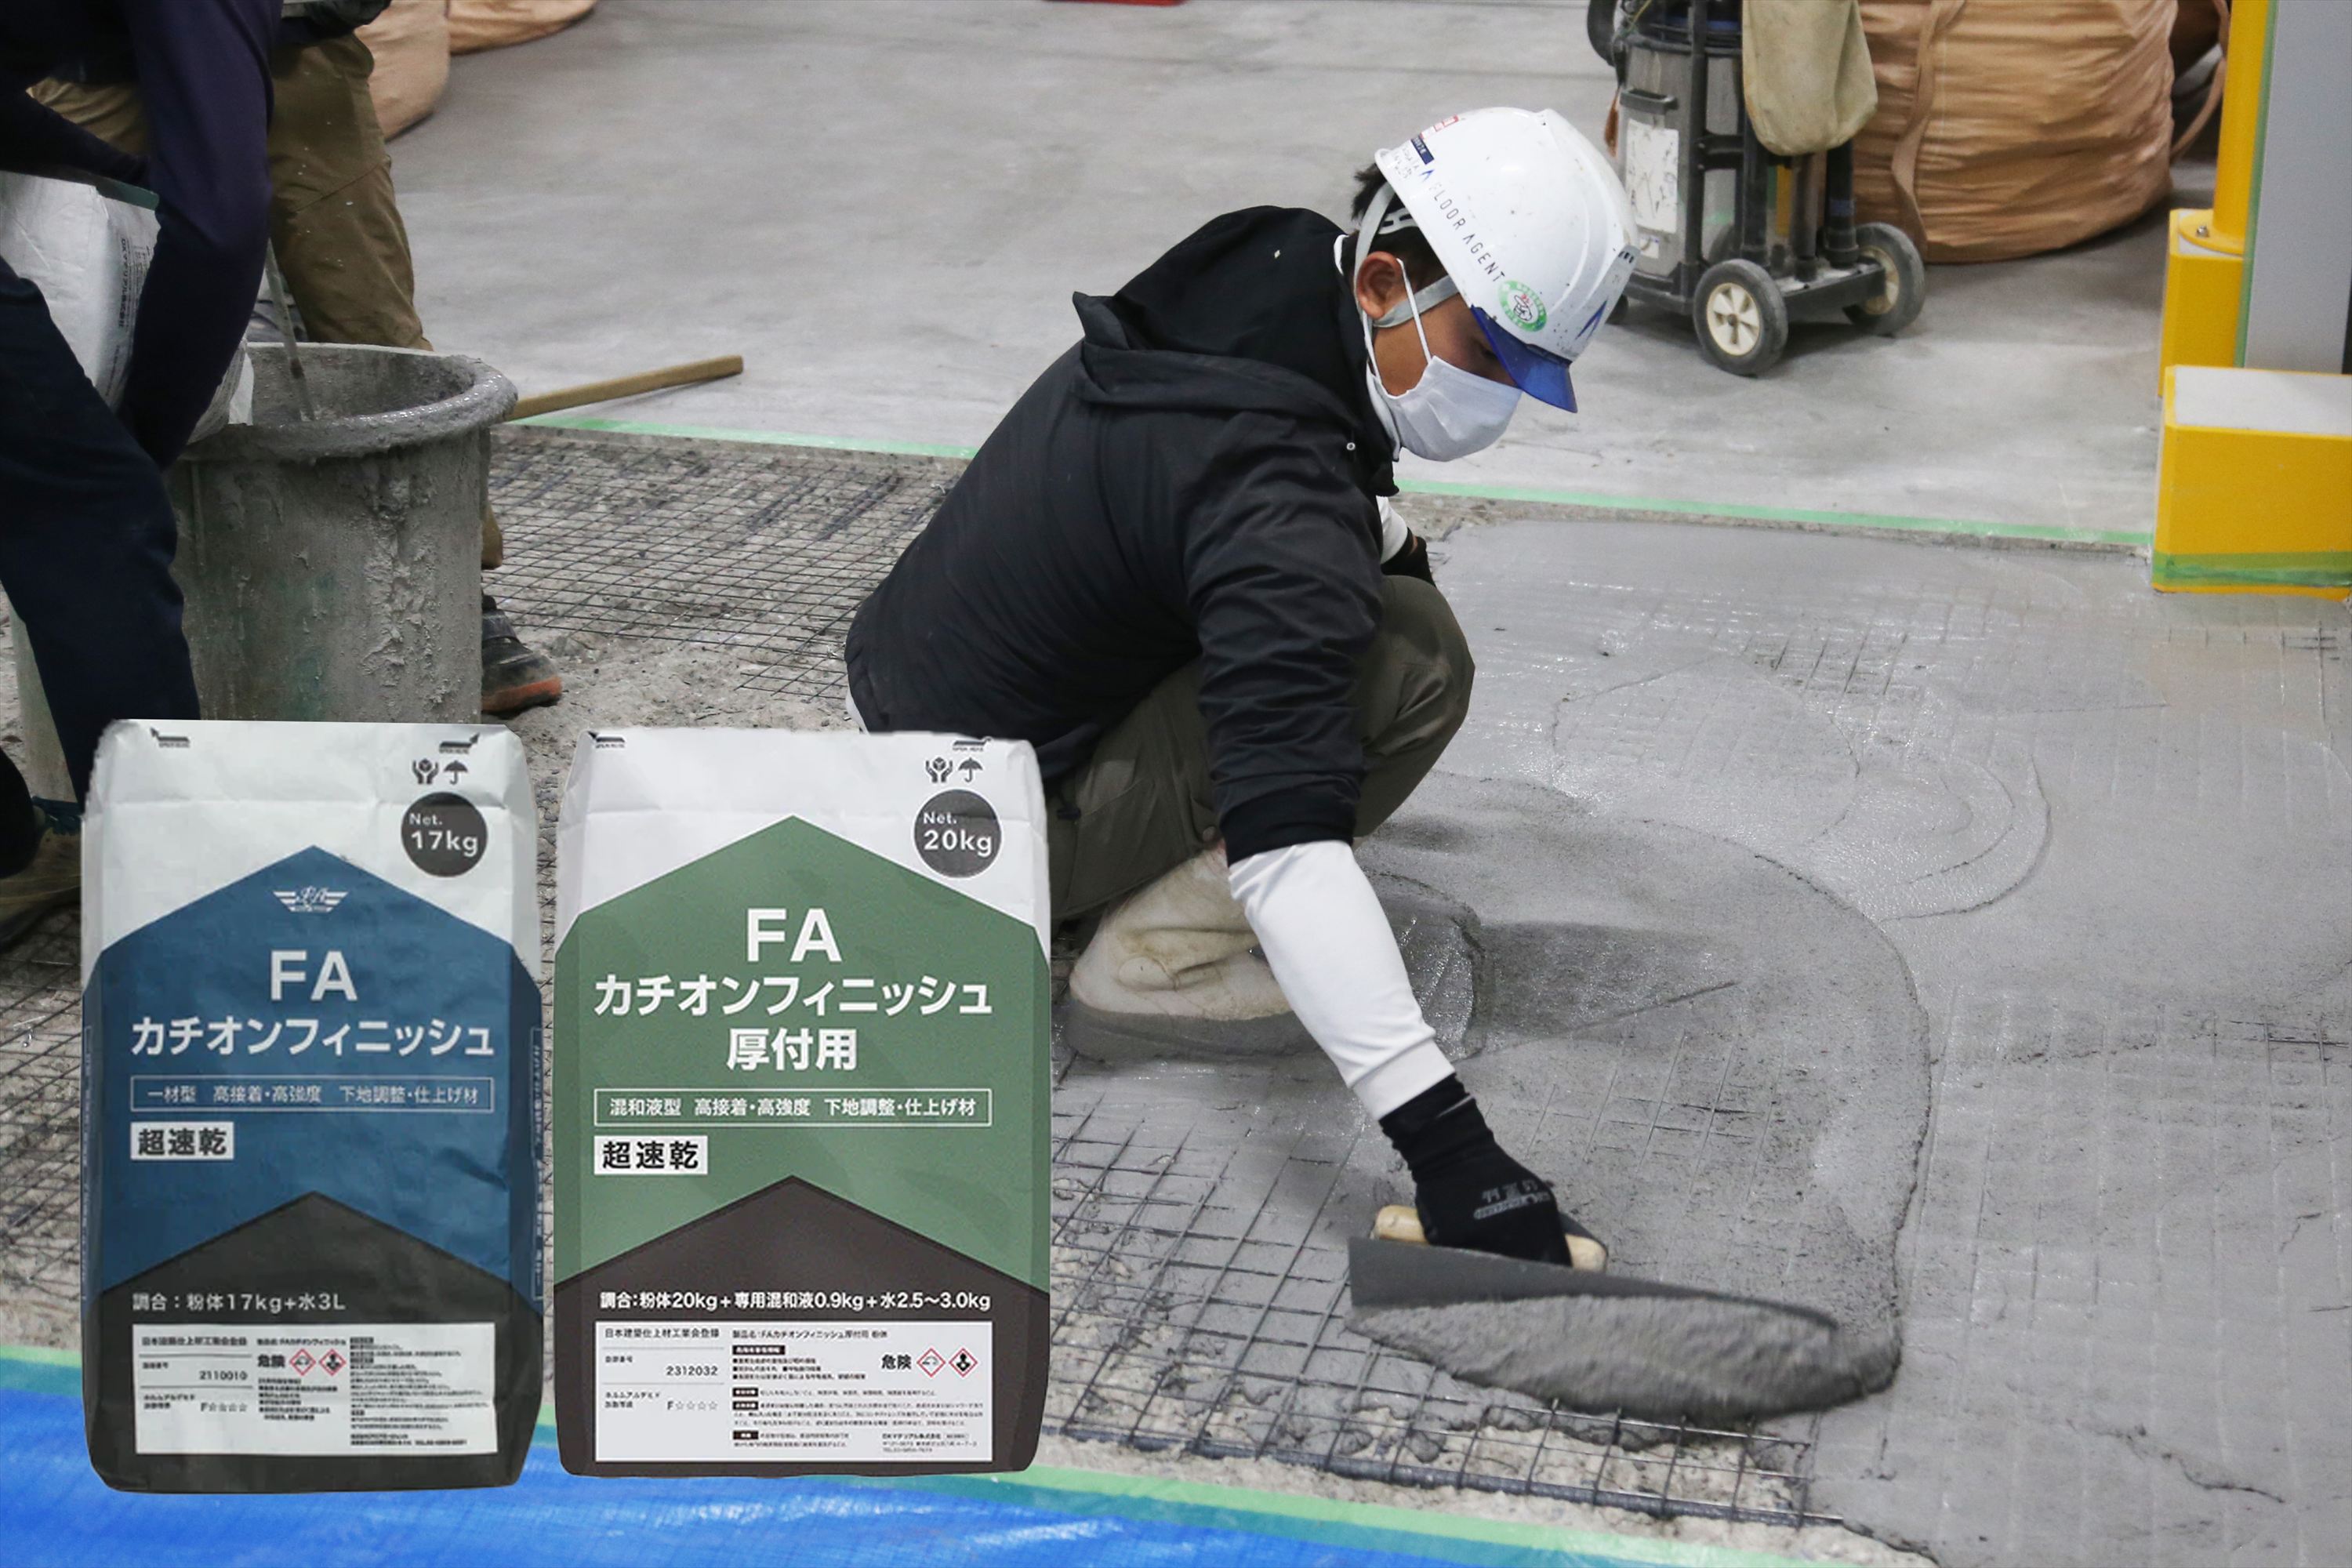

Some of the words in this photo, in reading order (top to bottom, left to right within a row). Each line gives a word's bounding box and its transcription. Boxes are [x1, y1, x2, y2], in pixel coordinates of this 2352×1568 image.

[1462, 233, 1505, 282] AGENT
[409, 813, 443, 826] Net.
[924, 811, 957, 824] Net.
[411, 829, 478, 857] 17kg
[924, 829, 992, 858] 20kg
[746, 908, 842, 962] FA
[270, 950, 358, 1001] FA
[594, 975, 993, 1016] カチオンフィニッシュ
[131, 1016, 495, 1056] カチオンフィニッシュ
[727, 1028, 858, 1070] 厚付用
[147, 1086, 196, 1103] 一材型
[609, 1098, 681, 1116] 混和液型
[138, 1127, 227, 1156] 超速乾
[603, 1141, 699, 1170] 超速乾
[199, 1370, 248, 1381] 2110010
[666, 1366, 718, 1376] 2312032
[881, 1354, 912, 1370] 危険
